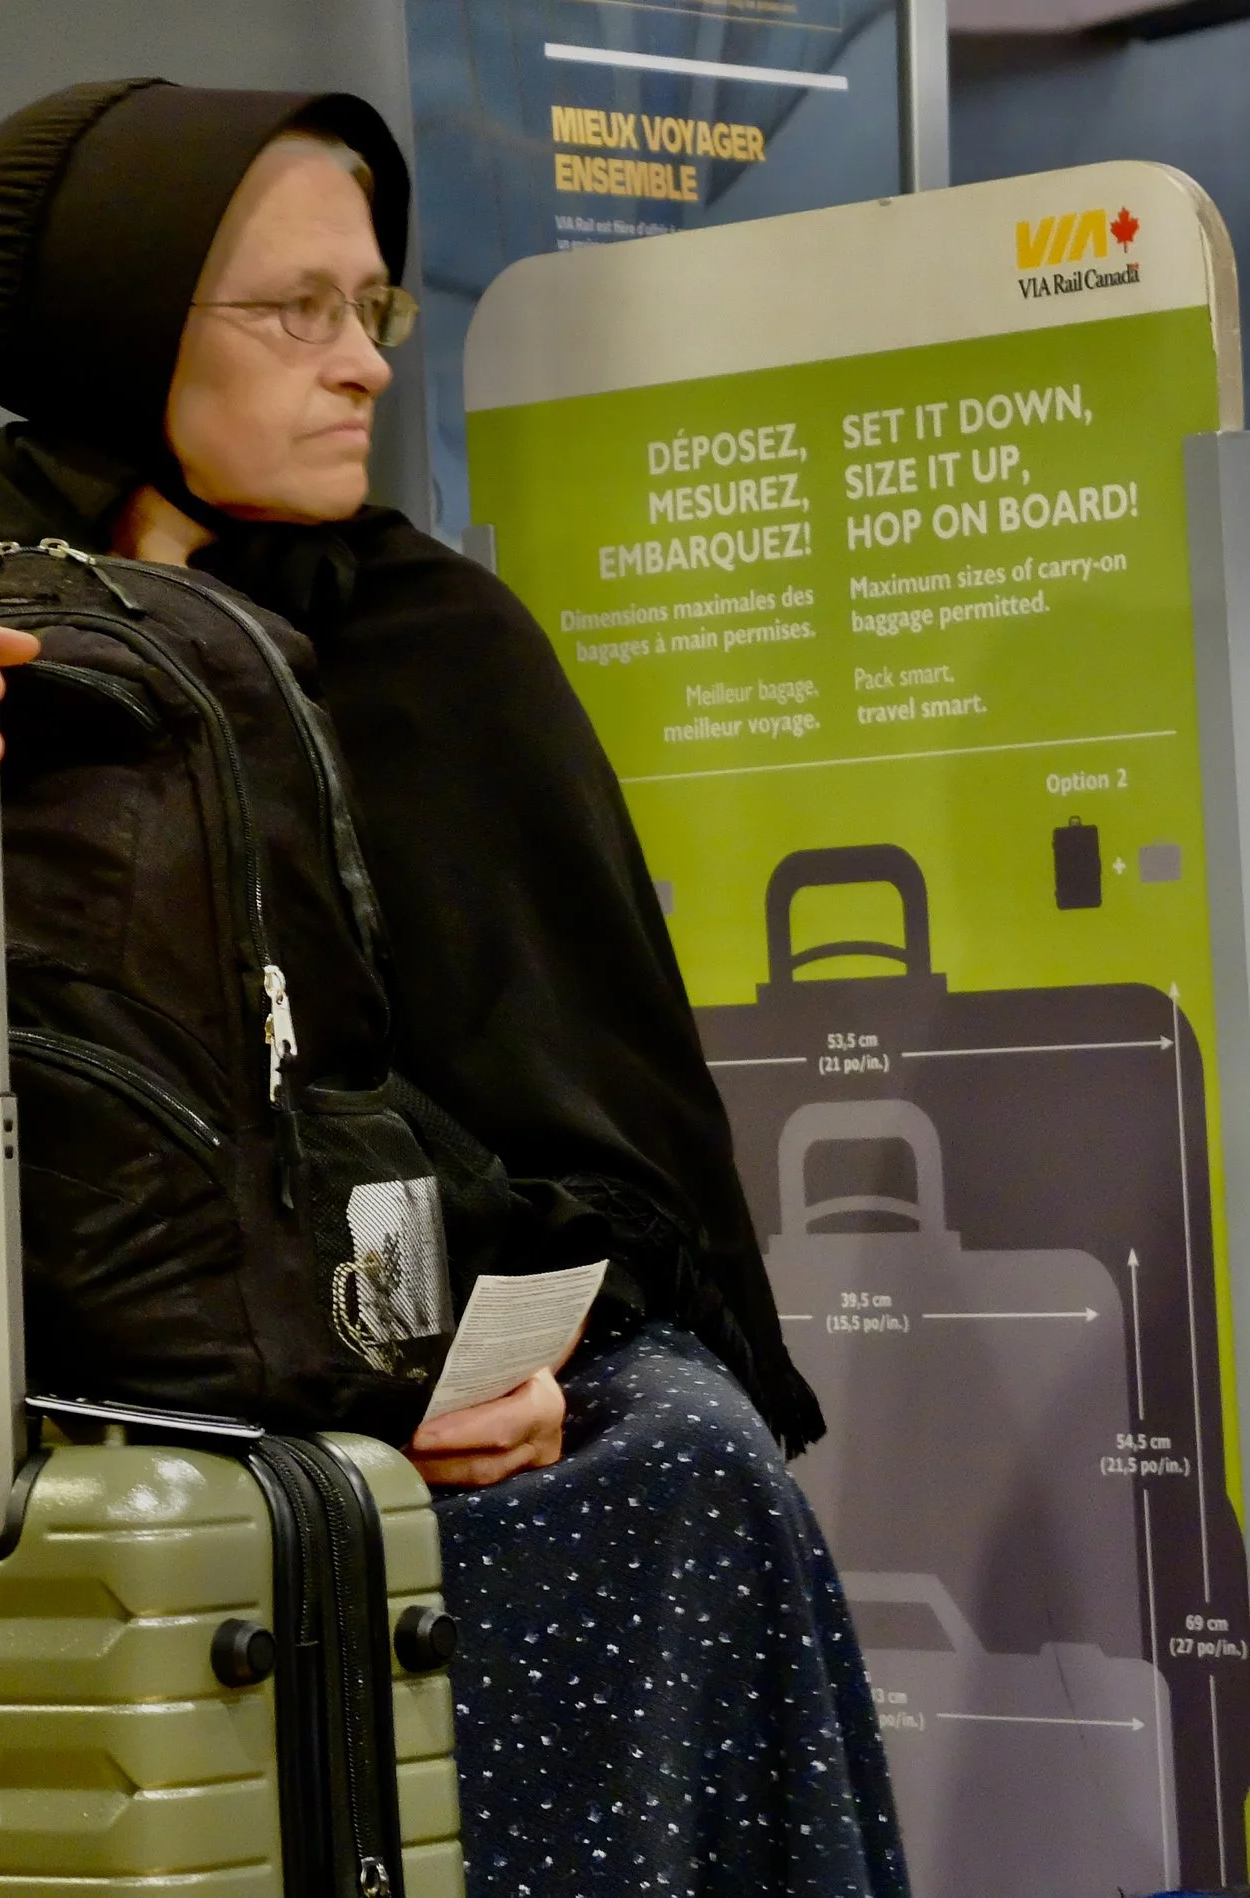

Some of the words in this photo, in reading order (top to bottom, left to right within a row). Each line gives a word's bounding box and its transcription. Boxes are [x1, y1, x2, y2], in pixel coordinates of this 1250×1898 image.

[551, 105, 638, 149] MIEUX
[642, 114, 766, 162] VOYAGER
[554, 153, 699, 203] ENSEMBLE
[1016, 208, 1107, 269] VIA
[1018, 276, 1051, 299] VIA
[1053, 271, 1083, 295] Rail
[1084, 263, 1140, 290] Canada
[842, 408, 905, 449] SET
[915, 402, 948, 440] IT
[959, 384, 1093, 434] DOWN,
[647, 423, 807, 475] DÉPOSEZ,
[844, 457, 918, 500] SIZE
[928, 452, 961, 489] IT
[972, 445, 1030, 486] UP,
[649, 473, 810, 525] MESUREZ,
[847, 508, 922, 550] HOP
[932, 500, 987, 540] ON
[998, 481, 1138, 532] BOARD!
[599, 522, 812, 580] EMBARQUEZ!
[850, 573, 951, 600] Maximum
[957, 564, 1005, 589] sizes
[1012, 557, 1033, 582] of
[1037, 553, 1127, 582] carry-on
[560, 603, 668, 632] Dimensions
[673, 589, 776, 620] maximales
[781, 585, 814, 608] des
[851, 607, 934, 636] baggage
[939, 589, 1050, 630] permitted.
[576, 638, 649, 666] bagages
[654, 632, 666, 653] à
[671, 627, 718, 651] main
[723, 619, 816, 652] permises.
[854, 665, 894, 691] Pack
[685, 682, 753, 709] Meilleur
[857, 696, 915, 724] travel
[921, 694, 988, 720] smart.
[663, 717, 742, 743] meilleur
[1046, 770, 1109, 796] Option
[1116, 768, 1129, 788] 2
[827, 1033, 856, 1050] 53,5
[858, 1034, 878, 1047] cm
[819, 1055, 841, 1075] (21
[844, 1054, 890, 1074] po/in.)
[872, 1294, 892, 1307] cm
[863, 1313, 910, 1333] po/in.)
[1116, 1433, 1147, 1452] 54,5
[1150, 1436, 1171, 1449] cm
[1100, 1456, 1137, 1476] (21,5
[1140, 1456, 1190, 1476] po/in.)
[1185, 1614, 1204, 1631] 69
[1206, 1619, 1229, 1631] cm
[1170, 1638, 1194, 1657] (27
[1197, 1639, 1248, 1660] po/in.)
[888, 1692, 908, 1704] cm
